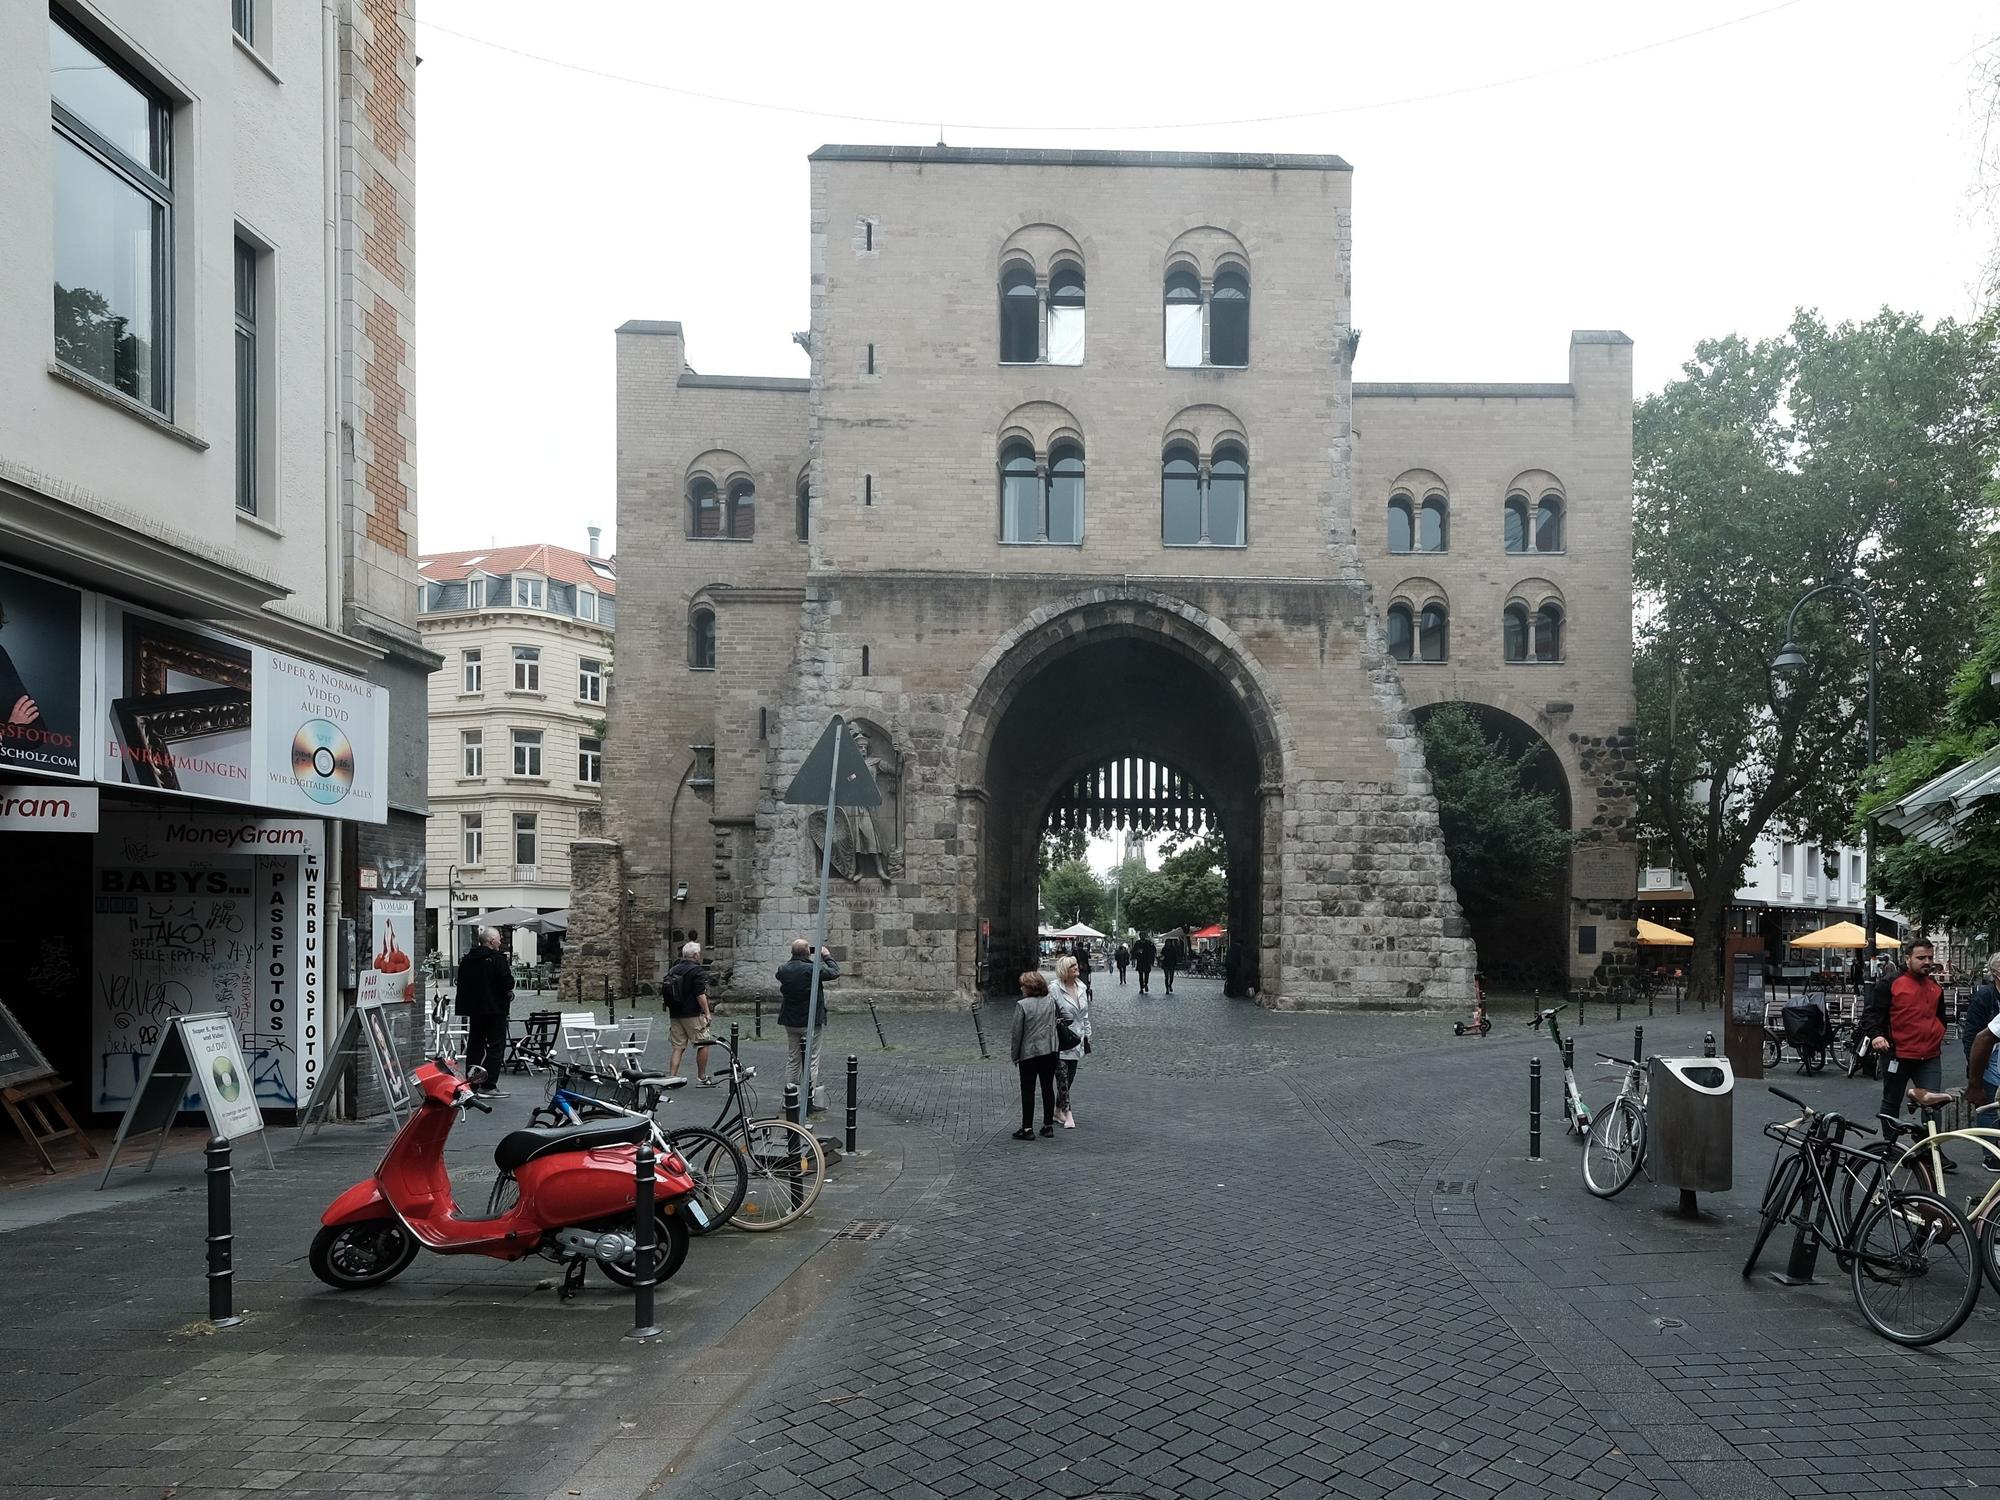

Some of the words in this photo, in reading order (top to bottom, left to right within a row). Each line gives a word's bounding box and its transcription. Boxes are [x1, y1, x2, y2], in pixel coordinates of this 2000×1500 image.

[272, 657, 306, 679] SUPER
[321, 673, 364, 695] NORMAL
[366, 687, 373, 699] 8
[307, 685, 342, 705] VIDEO
[300, 701, 321, 716] AUF
[324, 706, 350, 723] DVD
[107, 741, 248, 780] EINRAHMUNGEN
[269, 771, 288, 785] WIR
[289, 777, 351, 796] DIGITALISIEREN
[352, 788, 373, 799] ALLES
[165, 824, 304, 848] MoneyGram
[379, 902, 409, 911] YOMARO
[269, 872, 285, 1031] PASSFOTOS
[364, 975, 378, 987] PASS
